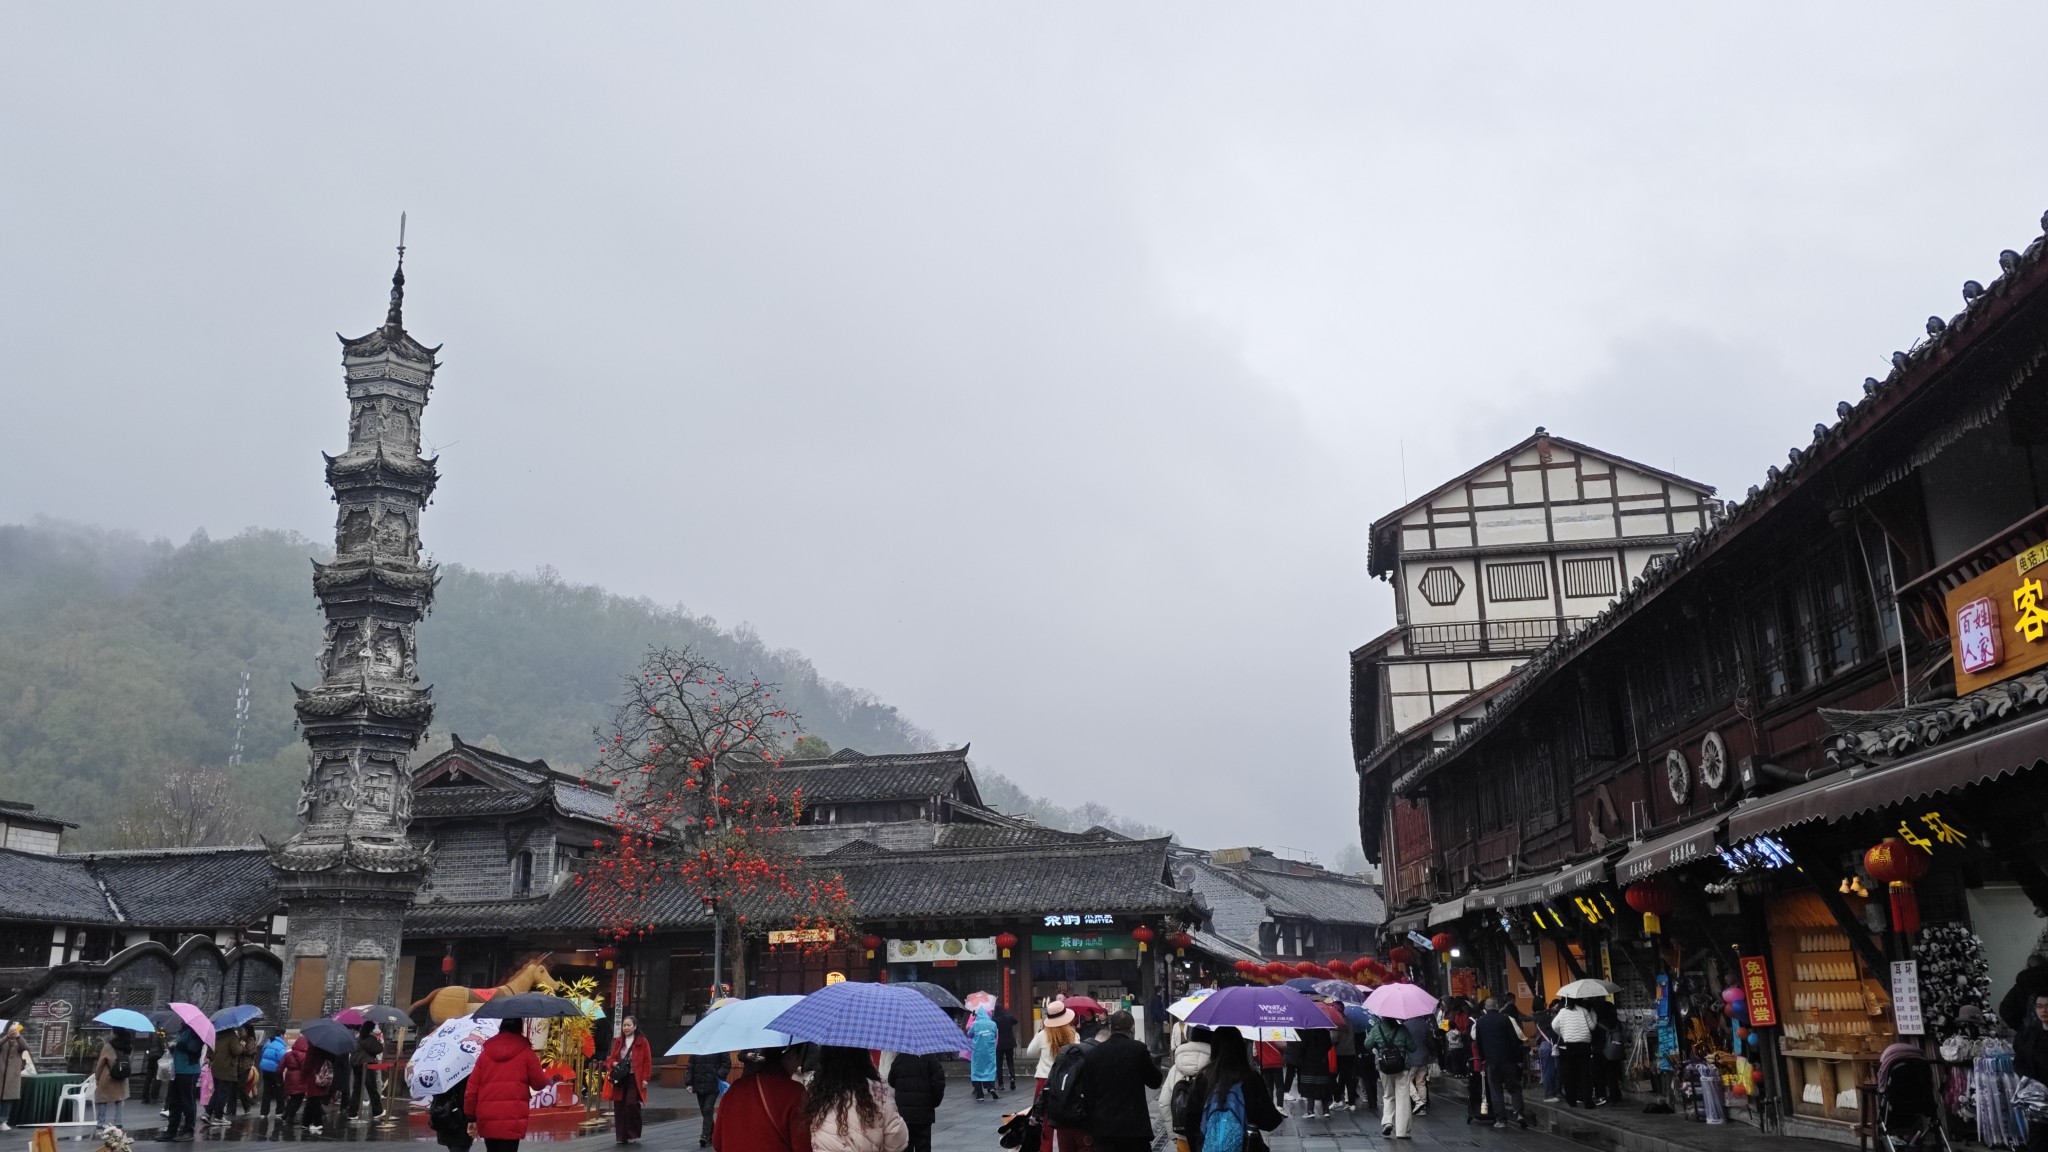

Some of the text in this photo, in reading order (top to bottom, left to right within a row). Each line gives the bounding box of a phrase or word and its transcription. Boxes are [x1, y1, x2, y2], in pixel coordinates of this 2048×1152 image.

[2013, 577, 2048, 643] 客
[1897, 811, 1968, 856] 耳环
[1745, 960, 1770, 1021] 免费品尝
[1894, 963, 1913, 976] 耳环
